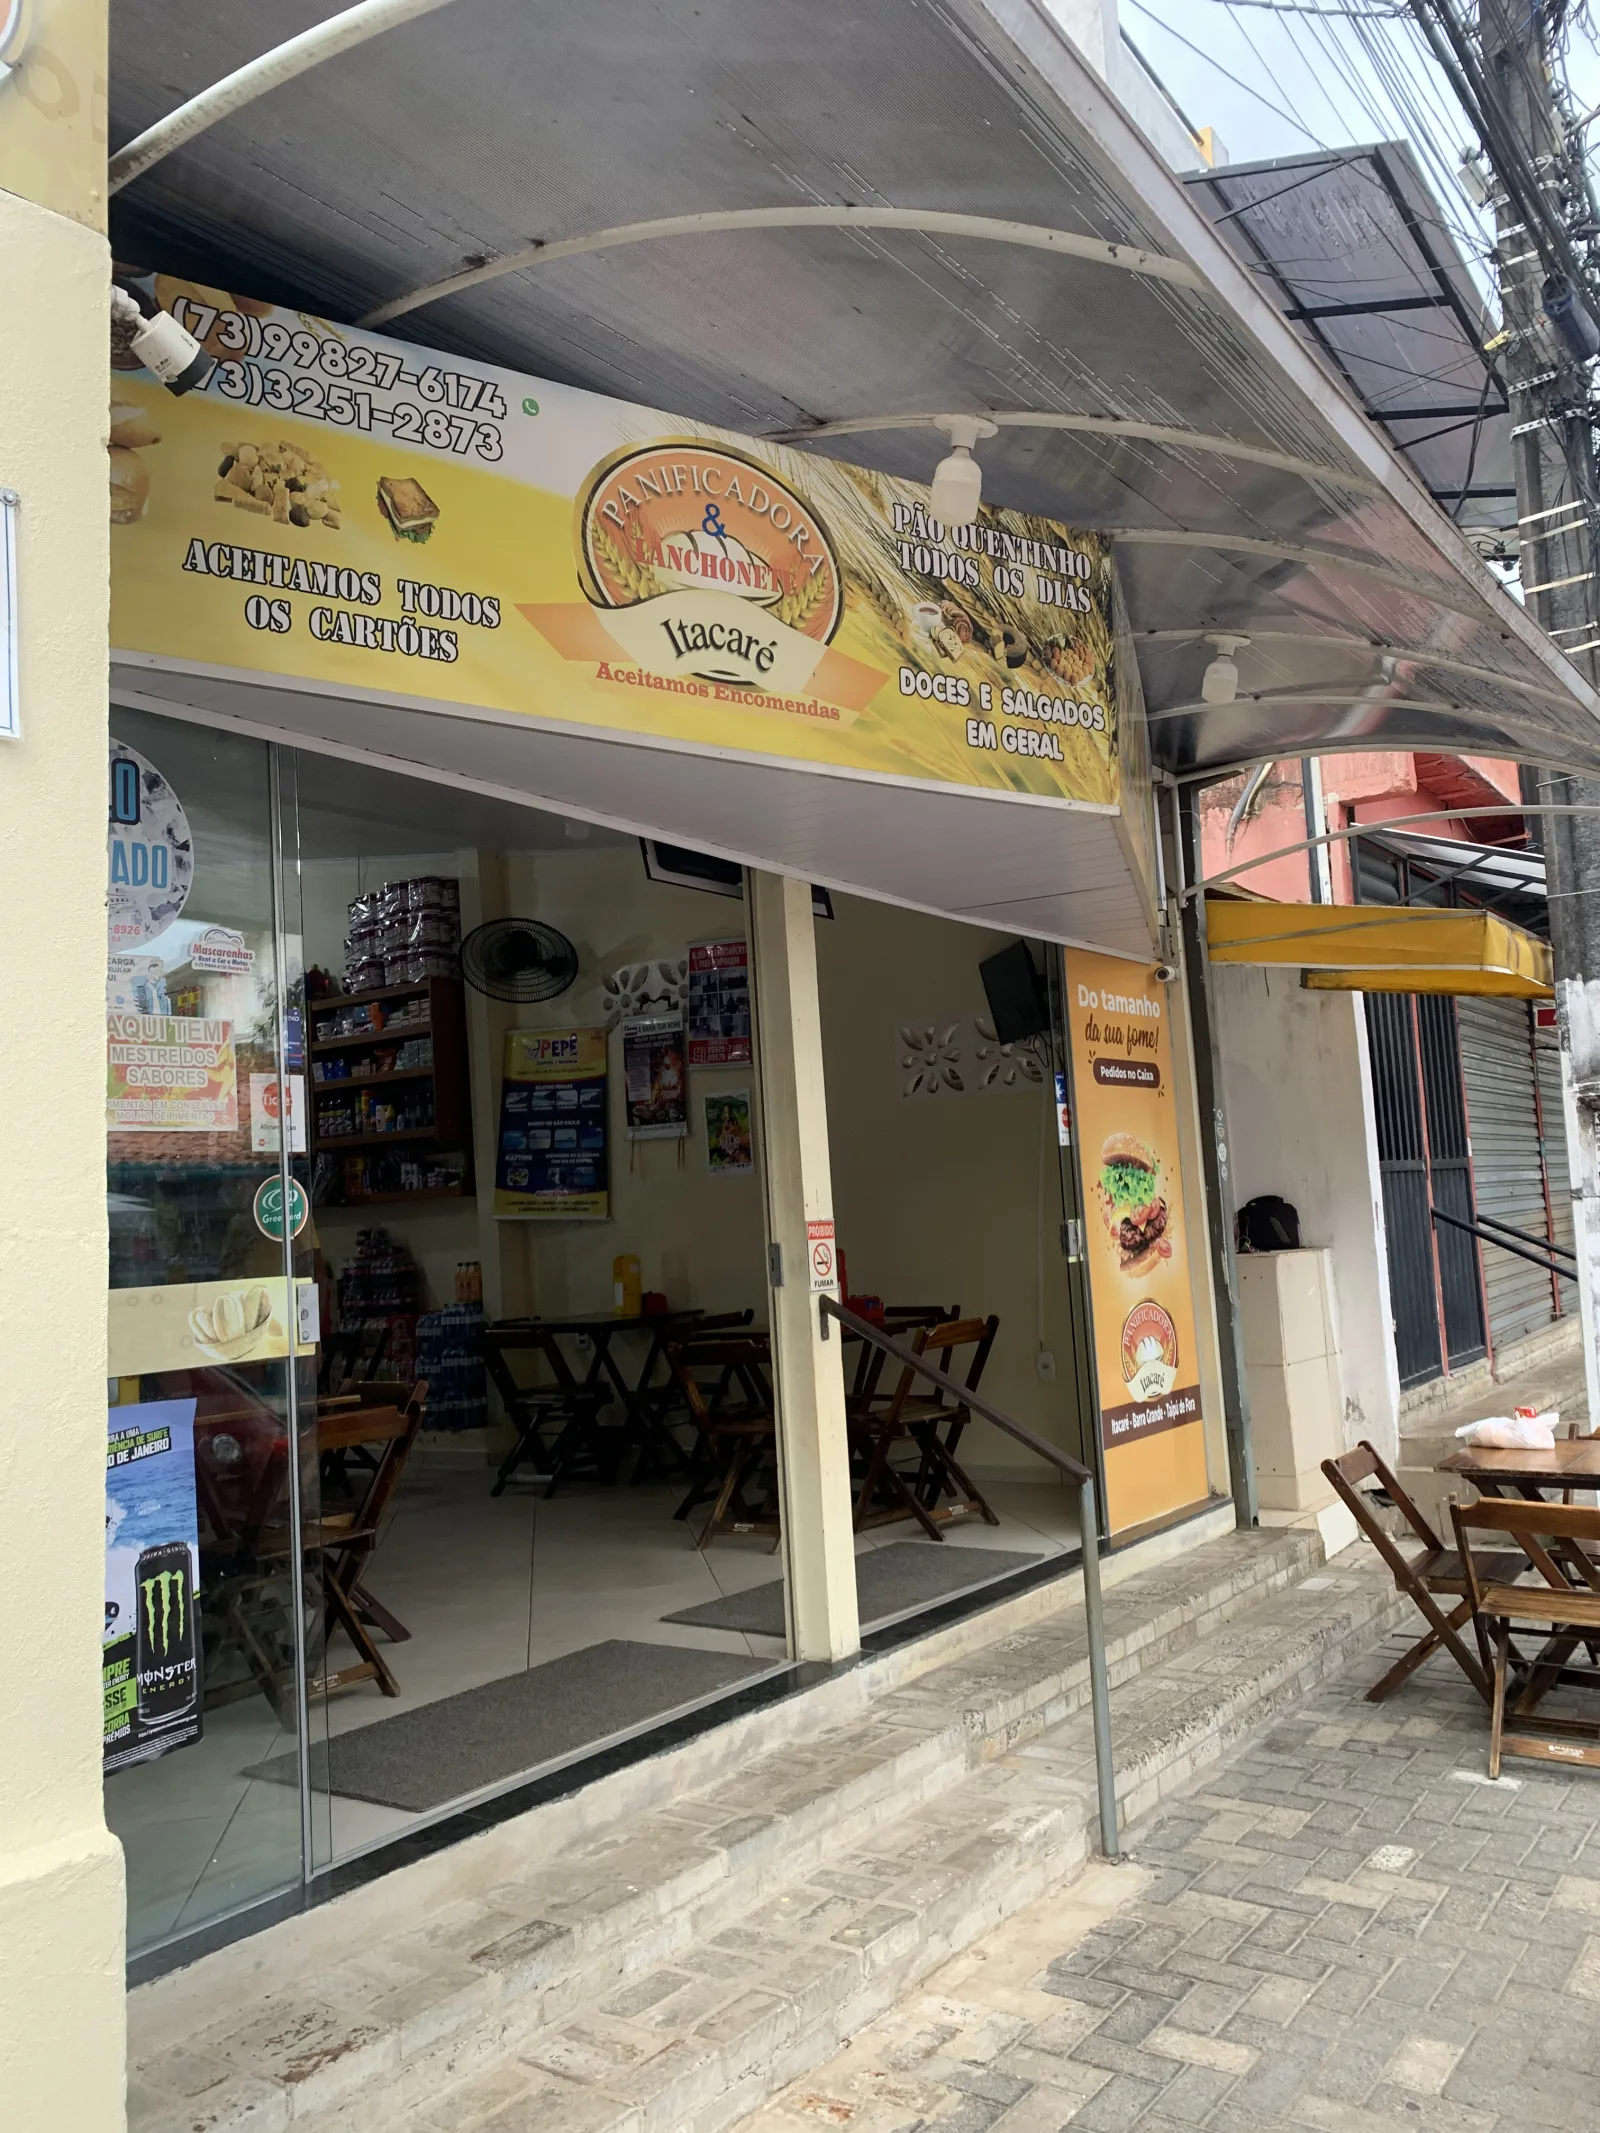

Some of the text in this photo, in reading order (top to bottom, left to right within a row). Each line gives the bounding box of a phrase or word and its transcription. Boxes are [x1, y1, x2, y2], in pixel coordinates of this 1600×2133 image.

[172, 297, 507, 419] (73)99827-6174
[602, 464, 825, 577] PANIFICADORA
[701, 503, 727, 540] &
[893, 501, 1092, 581] PÃO QUENTINHO
[635, 537, 799, 597] LANCHONETE
[897, 539, 1092, 614] TODOS OS DIAS
[183, 539, 502, 630] ACEITAMOS TODOS
[244, 595, 459, 663] OS CARTÕES
[660, 612, 779, 674] Itacaré
[595, 661, 840, 722] Aceitamos Encomendas
[899, 667, 1106, 732] DOCES E SALGADOS
[966, 719, 1064, 762] EM GERAL
[193, 943, 254, 960] Mascarenhas
[1078, 983, 1161, 1019] Do tamanho
[107, 1015, 223, 1043] AQUI TEM
[539, 1032, 578, 1059] PEPÊ
[1085, 1012, 1160, 1056] da sua fome!
[111, 1046, 217, 1067] MESTRE DOS
[127, 1068, 208, 1086] SABORES
[1100, 1065, 1154, 1082] Pedidos no Caixa
[117, 1111, 216, 1122] MOLHO DE PIMENTAS
[154, 1101, 168, 1110] EM
[170, 1101, 226, 1111] CONSERVAS
[808, 1225, 834, 1237] PROIBIDO
[814, 1279, 834, 1288] FUMAR
[1124, 1308, 1173, 1348] PANIFICADORA
[1139, 1372, 1166, 1393] Itacaré
[125, 1427, 140, 1439] UMA
[1111, 1413, 1129, 1436] Itacaré
[1132, 1412, 1146, 1429] Barra
[1146, 1404, 1164, 1425] Grande
[1165, 1399, 1179, 1421] Taipú
[1179, 1398, 1186, 1415] de
[1185, 1397, 1196, 1413] Fora
[116, 1449, 130, 1465] DE
[131, 1437, 170, 1460] JANEIRO
[136, 1435, 146, 1446] DE
[146, 1428, 169, 1442] SURFE
[136, 1657, 197, 1687] MONSTER
[142, 1675, 192, 1695] ENERGY
